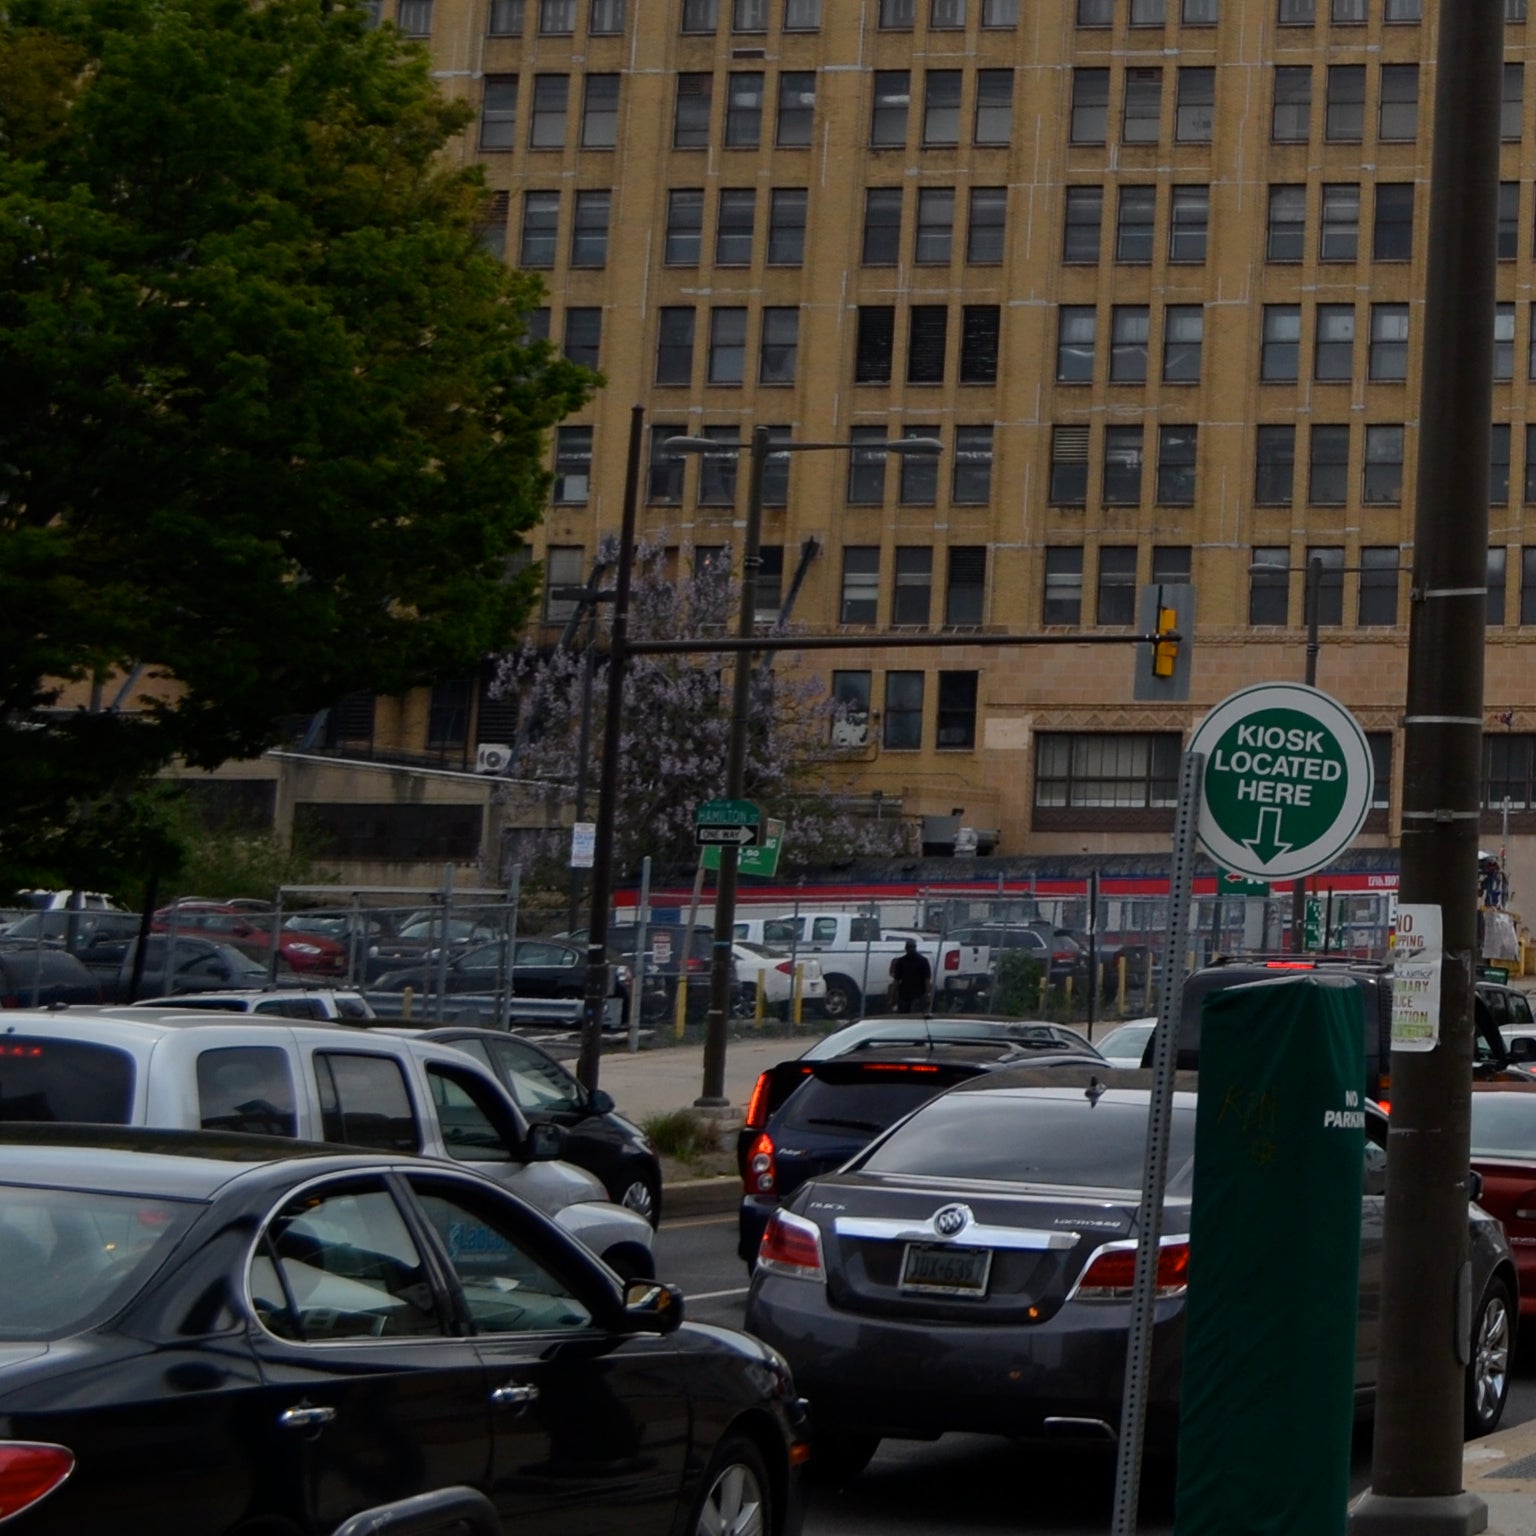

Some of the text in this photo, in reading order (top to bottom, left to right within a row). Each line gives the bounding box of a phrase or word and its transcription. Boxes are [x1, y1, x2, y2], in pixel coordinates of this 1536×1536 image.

[1237, 724, 1325, 754] KIOSK
[1214, 750, 1341, 782] LOCATED
[1238, 780, 1313, 806] HERE
[697, 809, 747, 823] HAMILTON
[703, 830, 740, 839] ONE WAY
[1396, 913, 1413, 933] NO
[1345, 1089, 1359, 1108] NO
